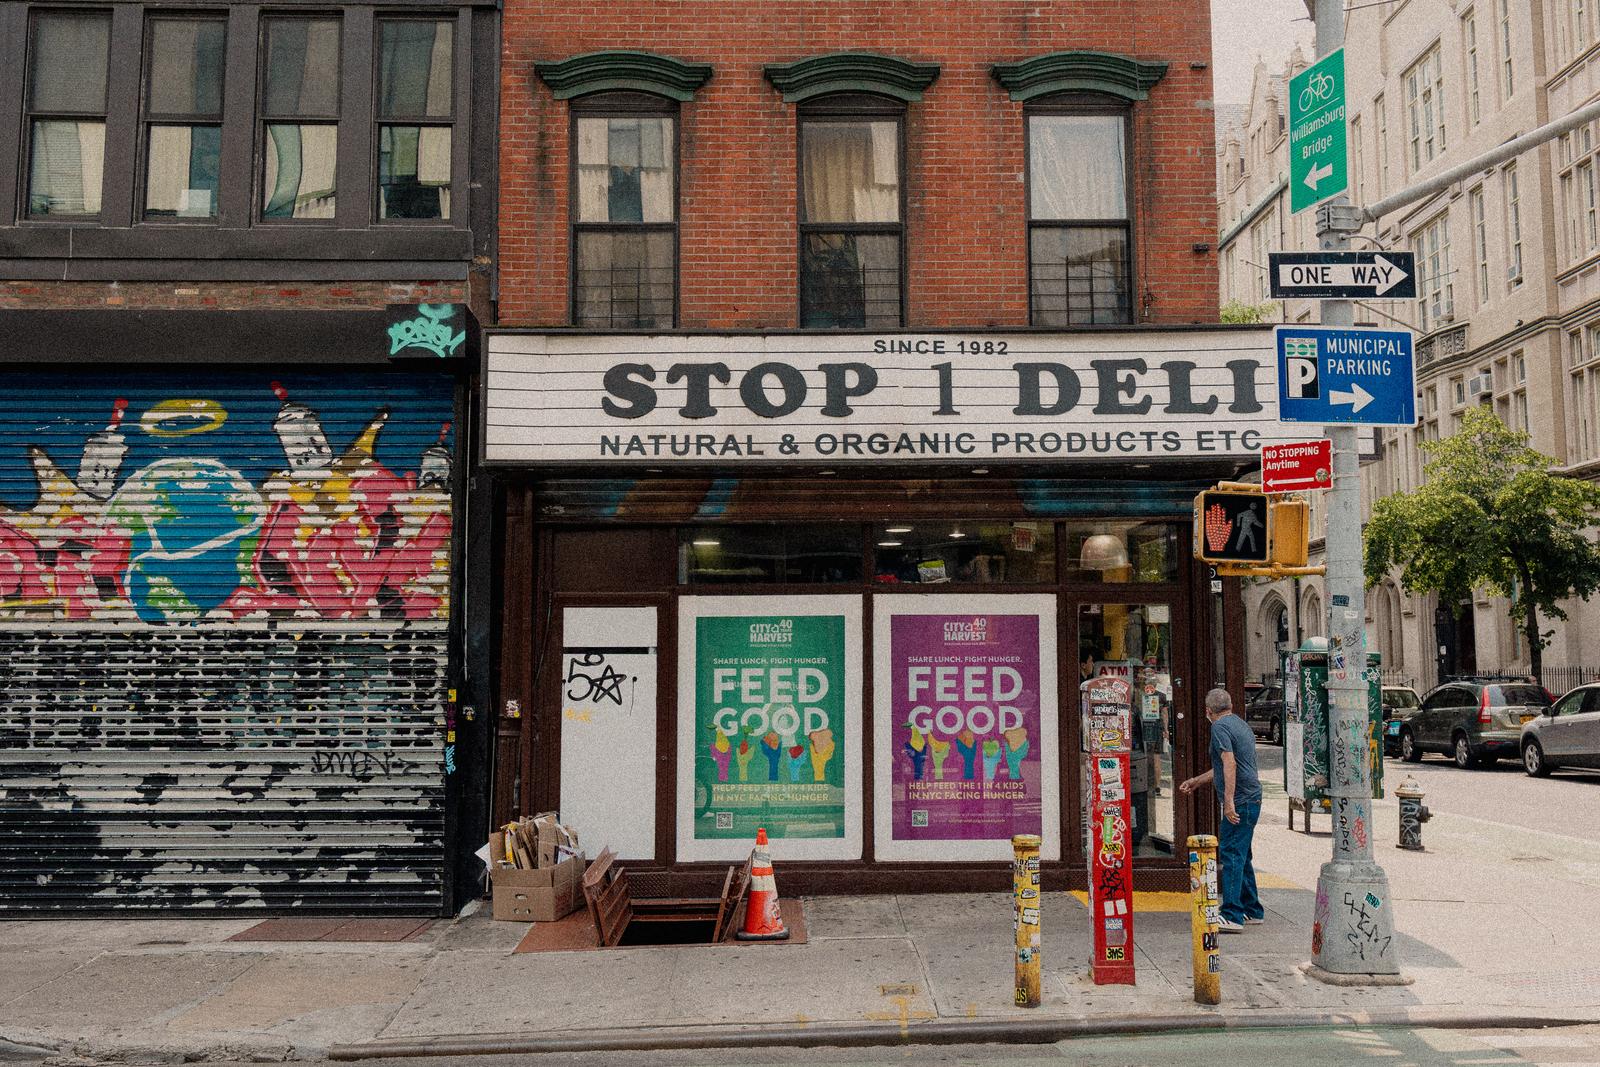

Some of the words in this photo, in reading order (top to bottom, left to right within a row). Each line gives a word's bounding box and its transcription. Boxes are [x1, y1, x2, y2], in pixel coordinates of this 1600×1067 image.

[1292, 105, 1345, 143] Williamsburg
[1302, 135, 1333, 159] Bridge
[1291, 266, 1332, 284] ONE
[1352, 266, 1393, 284] WAY
[874, 340, 946, 354] SINCE
[957, 340, 1009, 355] 1982
[1326, 338, 1406, 355] MUNICIPAL
[1327, 359, 1391, 376] PARKING
[602, 361, 879, 419] STOP
[931, 362, 960, 416] 1
[1013, 358, 1263, 416] DELI
[601, 434, 764, 456] NATURAL
[778, 433, 800, 455] &
[815, 432, 977, 455] ORGANIC
[992, 430, 1181, 453] PRODUCTS
[1196, 429, 1262, 451] ETC
[1265, 450, 1277, 459] NO
[1279, 446, 1319, 457] STOPPING
[1266, 460, 1300, 471] Anytime
[750, 623, 771, 633] CITY
[780, 619, 793, 629] 40
[944, 622, 965, 631] CITY
[973, 618, 987, 627] 40
[750, 632, 793, 642] HARVEST
[944, 631, 987, 641] HARVEST
[1100, 666, 1128, 676] ATM
[713, 668, 829, 704] FEED
[908, 666, 1023, 702] FEED
[713, 707, 829, 736] GOOD
[908, 705, 1023, 735] GOOD
[909, 782, 932, 790] HELP
[933, 782, 956, 790] FEED
[959, 782, 975, 790] THE
[983, 782, 993, 790] IN
[995, 782, 1001, 790] 4
[1003, 782, 1024, 790] KIDS
[787, 793, 829, 801] HUNGER
[909, 791, 920, 800] IN
[922, 791, 941, 800] NYC
[944, 791, 981, 800] FACING
[983, 791, 1024, 800] HUNGER
